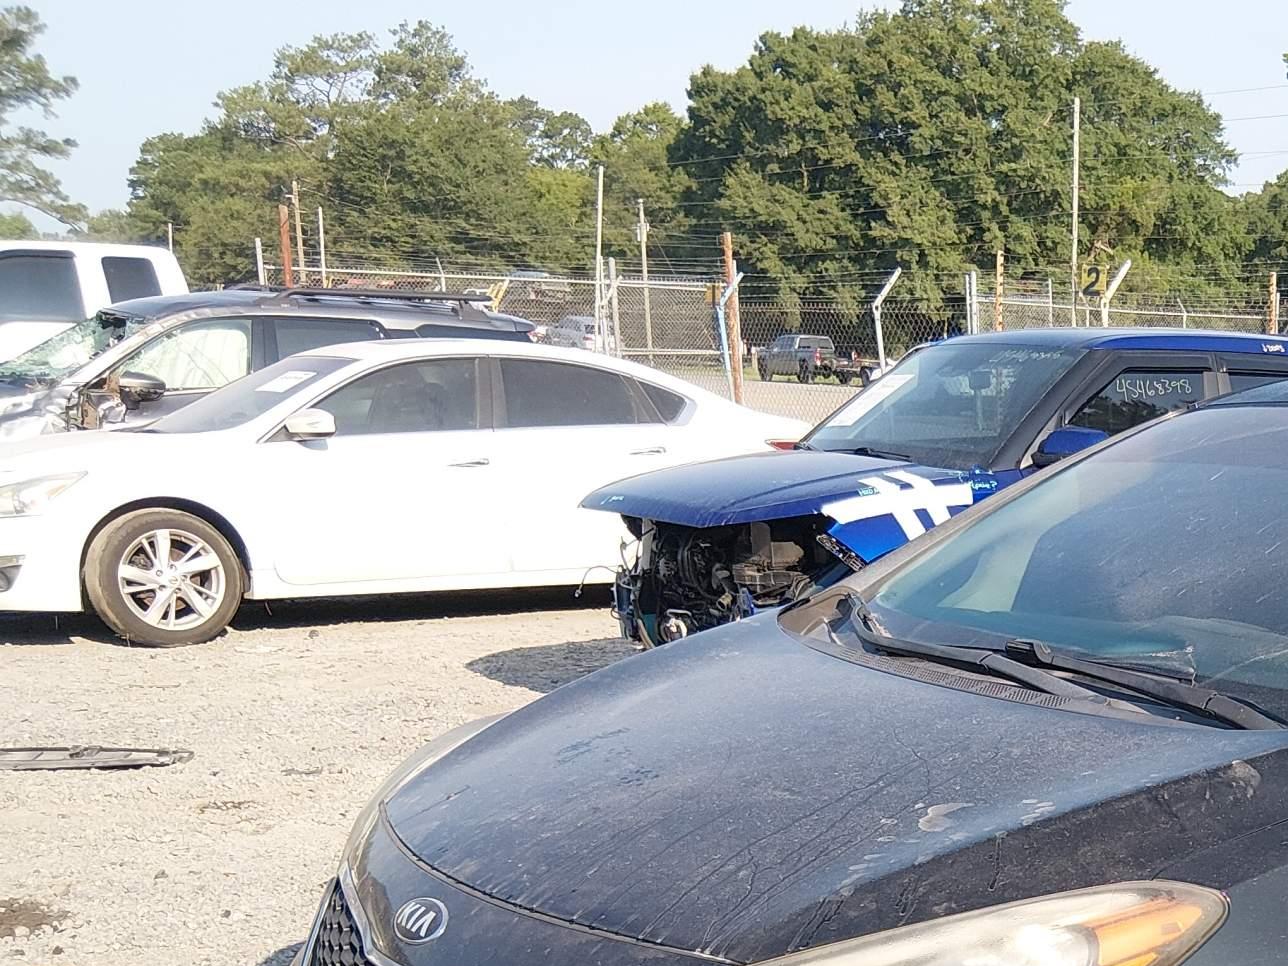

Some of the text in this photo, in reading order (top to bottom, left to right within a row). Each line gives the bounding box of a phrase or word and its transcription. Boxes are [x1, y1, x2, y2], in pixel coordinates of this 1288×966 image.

[1082, 266, 1100, 296] 2
[1115, 378, 1192, 401] 45468398
[397, 902, 437, 938] KIA
